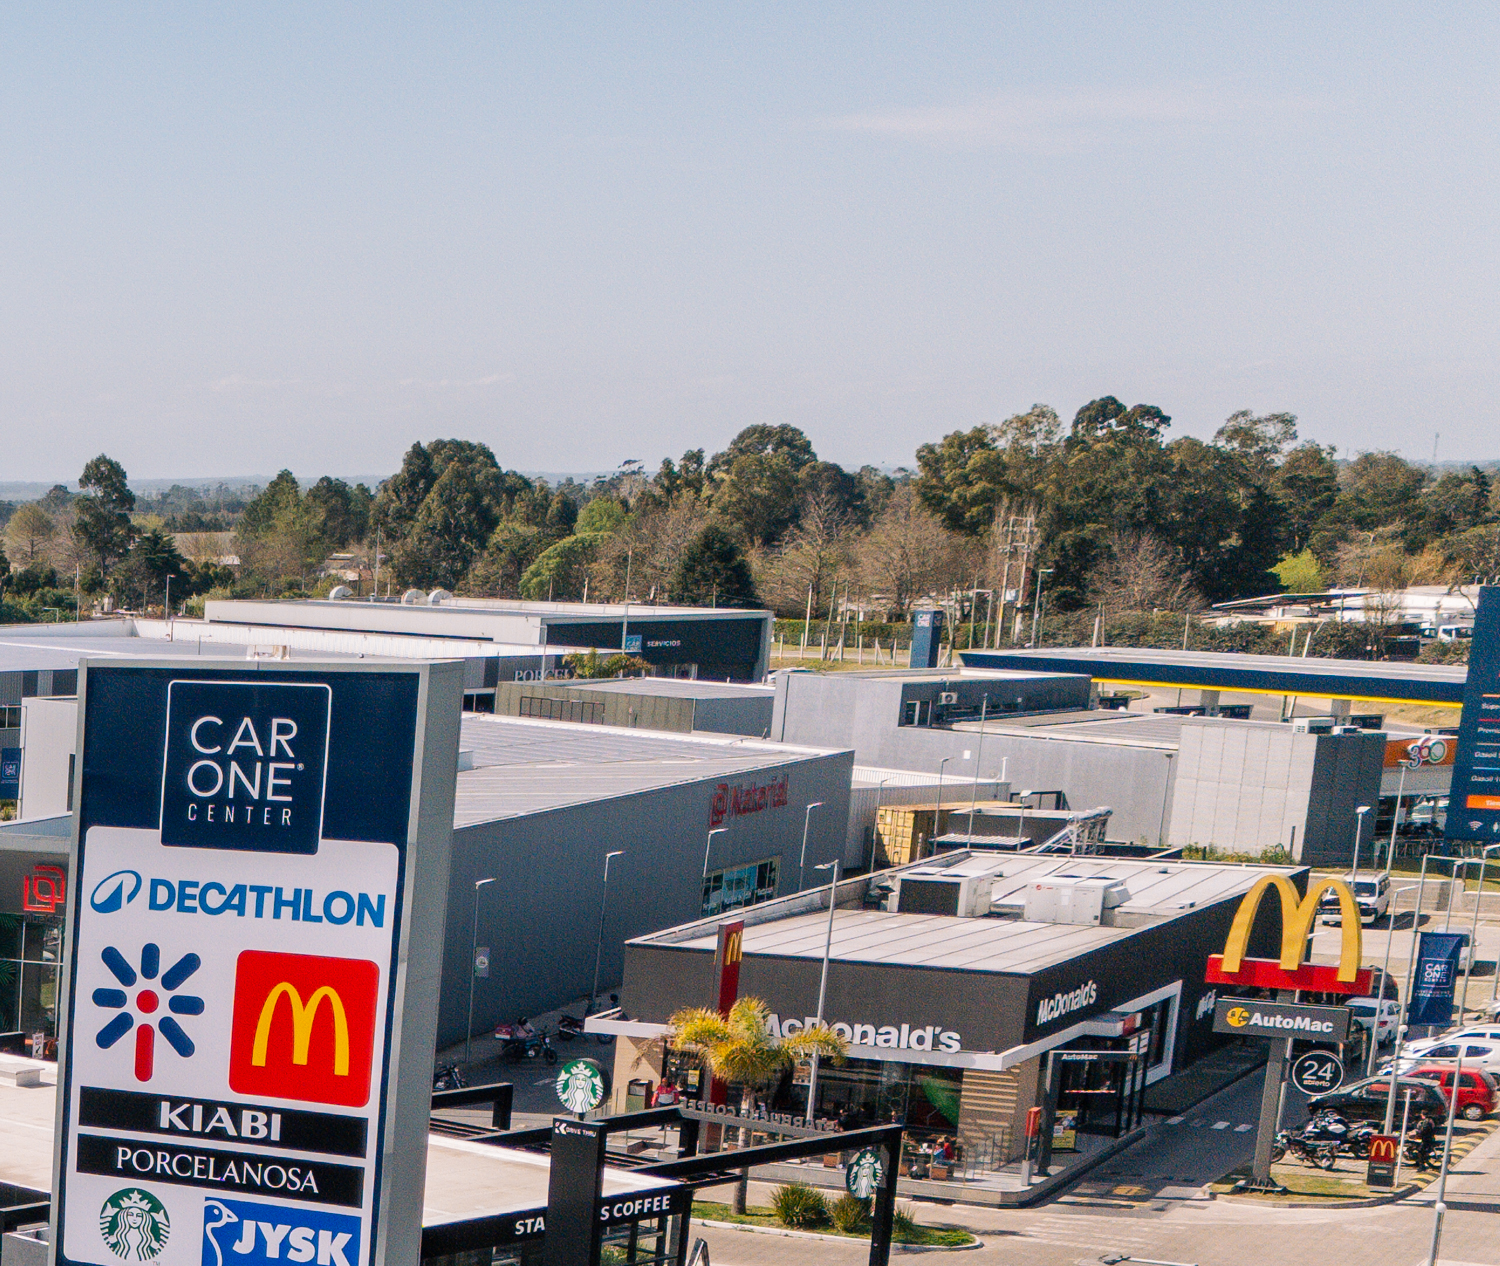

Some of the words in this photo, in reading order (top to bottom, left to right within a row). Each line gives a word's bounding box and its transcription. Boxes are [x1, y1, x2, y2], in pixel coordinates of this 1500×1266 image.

[189, 715, 299, 758] CAR
[187, 759, 294, 802] ONE
[187, 803, 294, 827] CENTER
[149, 876, 387, 929] DECATHLON
[1037, 980, 1098, 1026] McDonald's
[1249, 1012, 1334, 1034] AutoMac
[1302, 1060, 1333, 1080] 24
[158, 1101, 281, 1142] KIABI
[582, 1129, 597, 1137] THRU
[117, 1146, 319, 1194] PORCELANOSA
[612, 1194, 671, 1218] COFFEE
